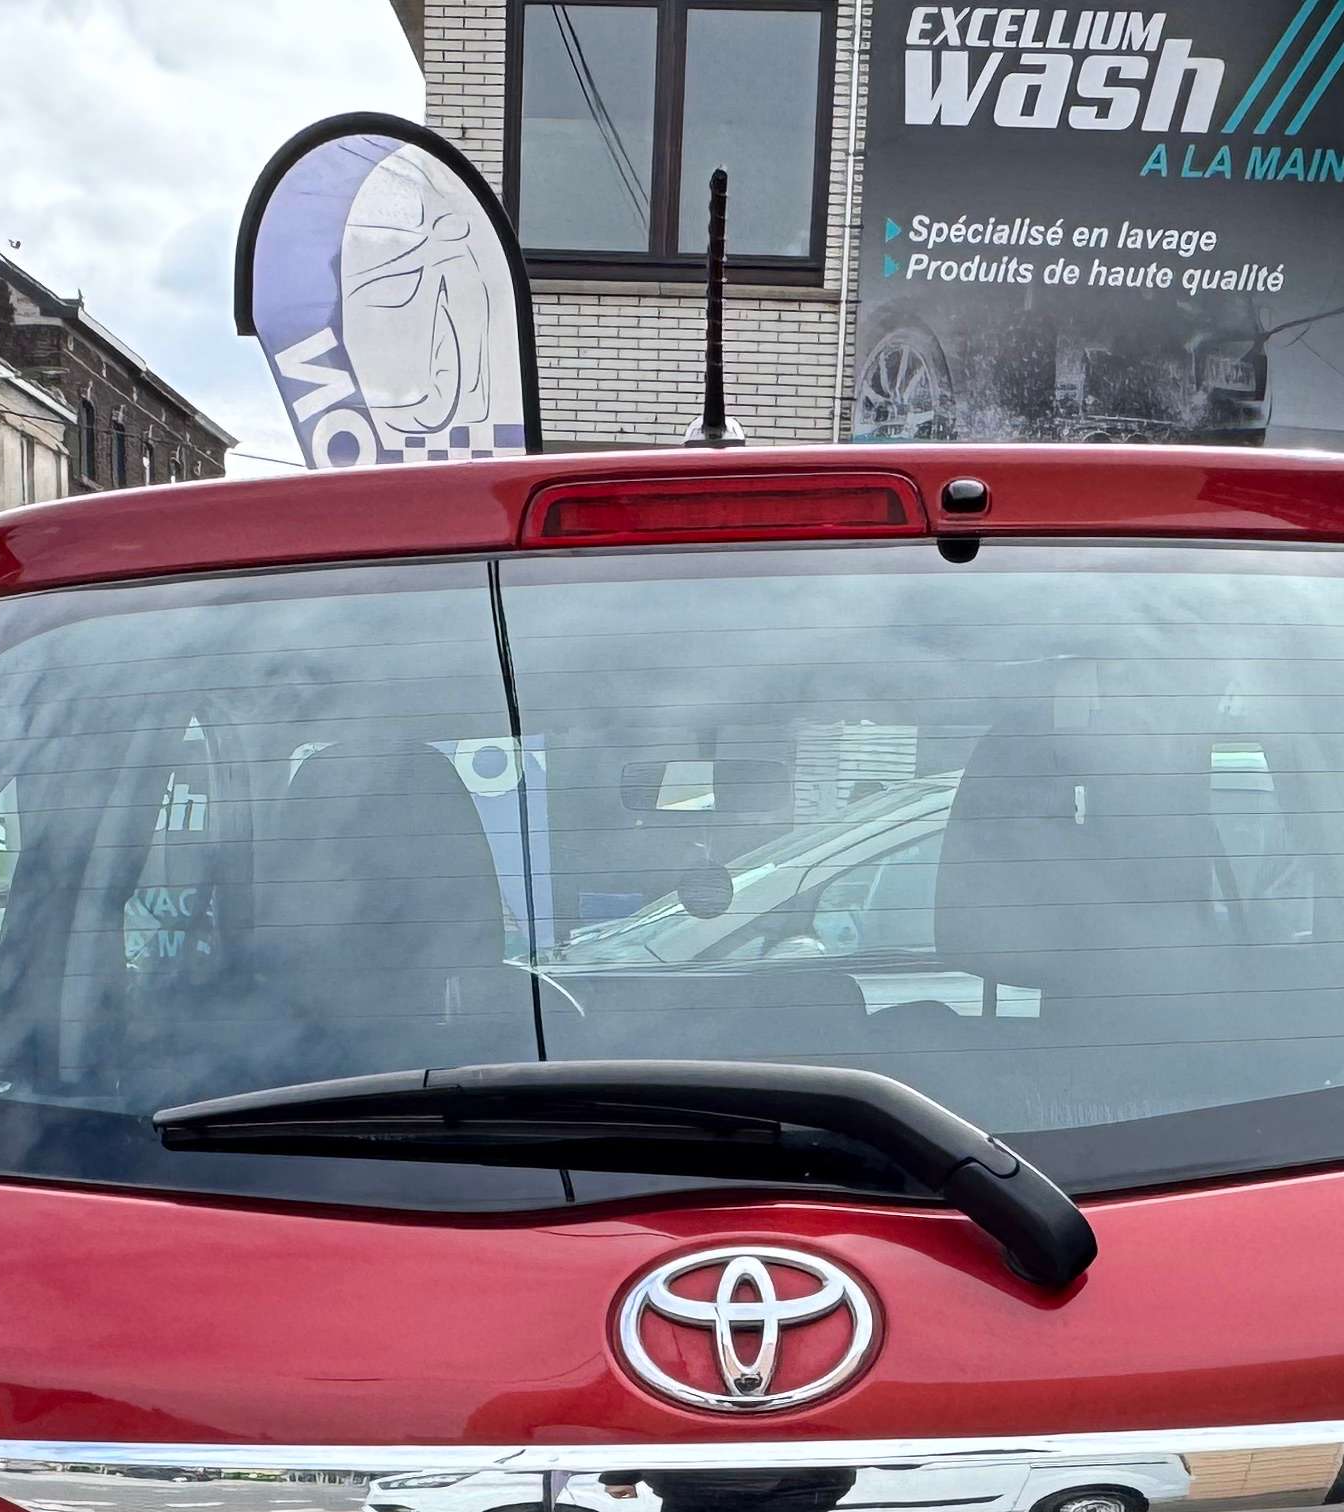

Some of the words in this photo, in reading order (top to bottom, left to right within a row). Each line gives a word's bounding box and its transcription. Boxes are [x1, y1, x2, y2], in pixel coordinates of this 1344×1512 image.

[905, 6, 1168, 52] EXCELLIUM
[904, 38, 1226, 135] wash
[1140, 143, 1169, 179] A
[1182, 145, 1233, 181] LA
[908, 214, 1064, 249] Spécialisé
[1072, 226, 1109, 248] en
[1118, 219, 1218, 254] lavage
[905, 253, 1034, 285] Produits
[1043, 257, 1081, 287] de
[1088, 258, 1173, 291] haute
[1182, 263, 1286, 296] qualité
